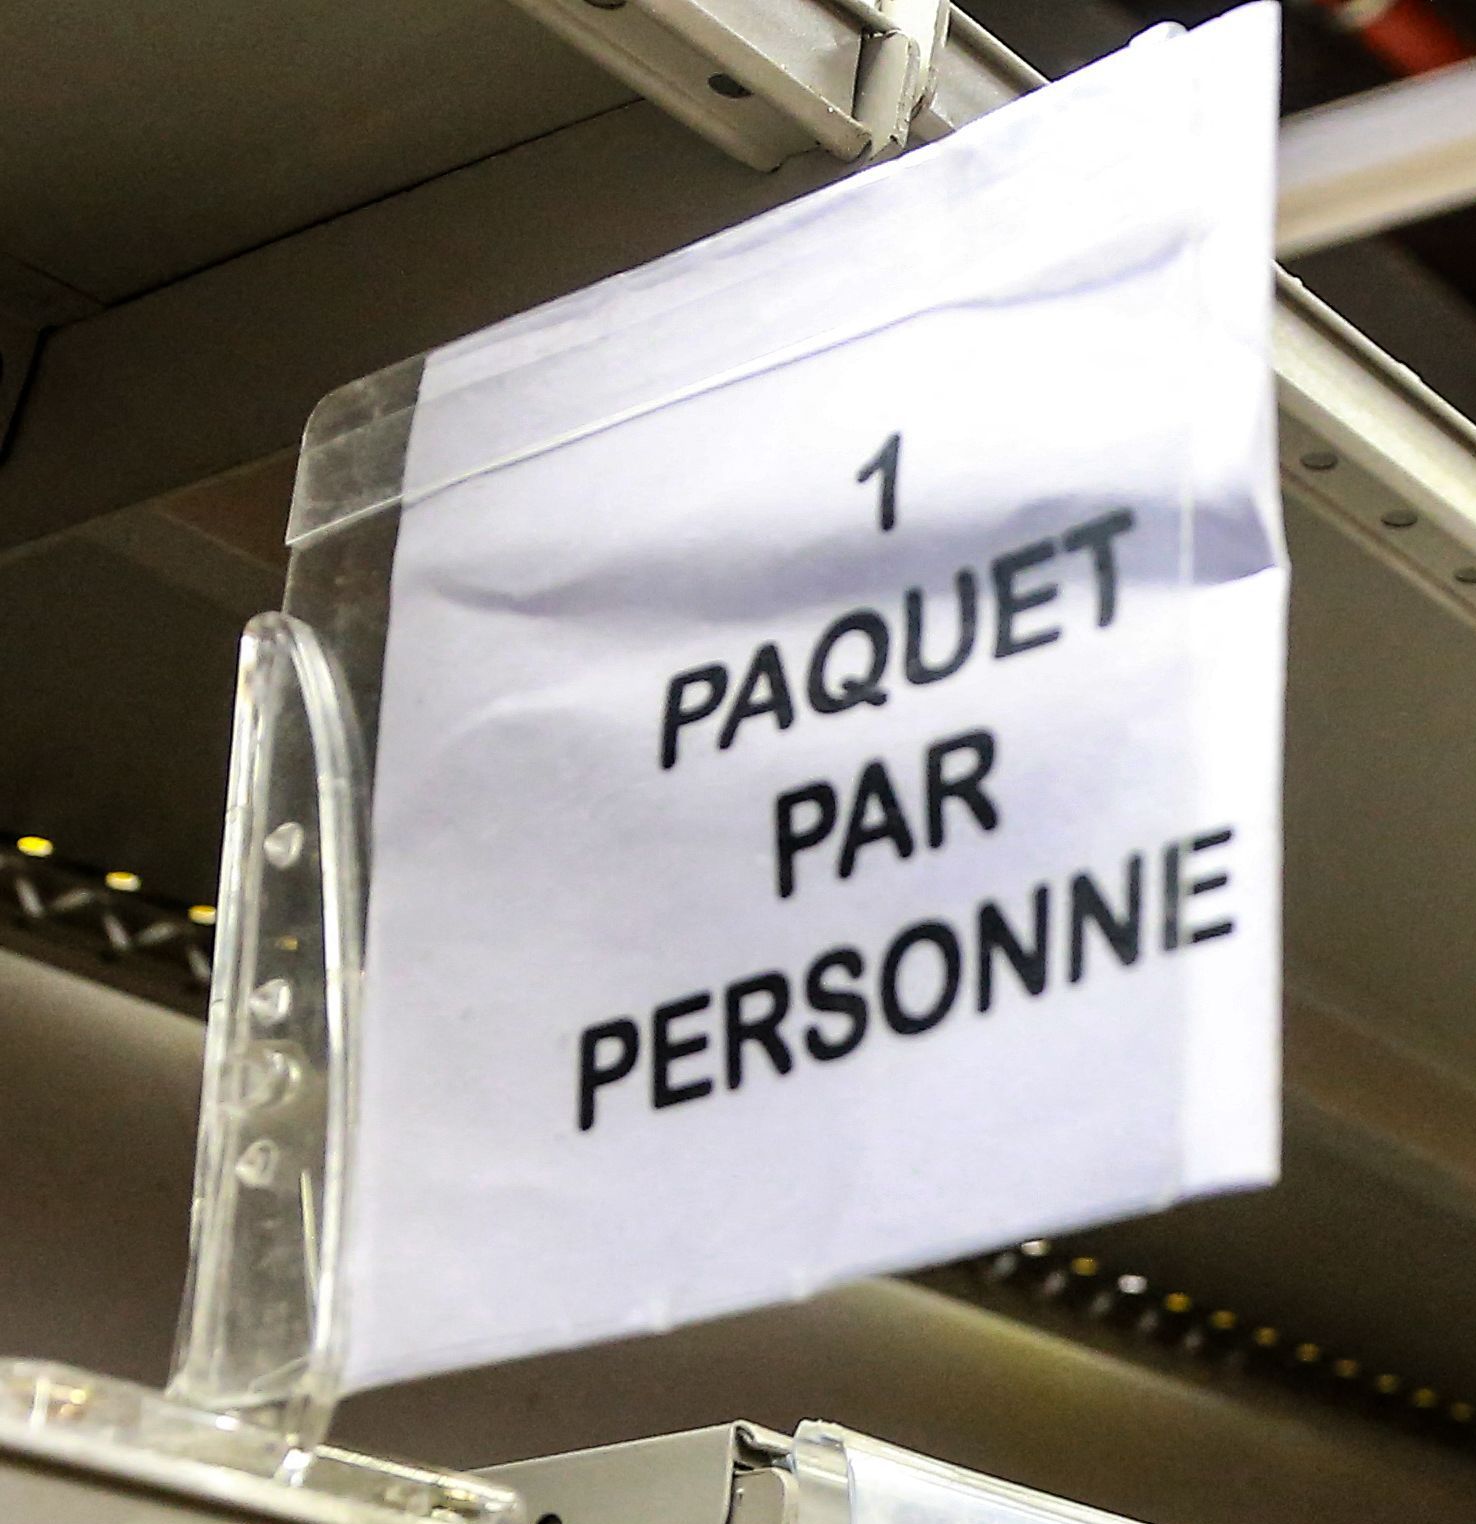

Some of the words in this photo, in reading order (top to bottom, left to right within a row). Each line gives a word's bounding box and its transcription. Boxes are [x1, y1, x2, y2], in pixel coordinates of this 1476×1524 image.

[856, 432, 902, 533] 1
[659, 506, 1135, 771] PAQUET
[774, 728, 1000, 900] PAR
[576, 826, 1235, 1134] PERSONNE
